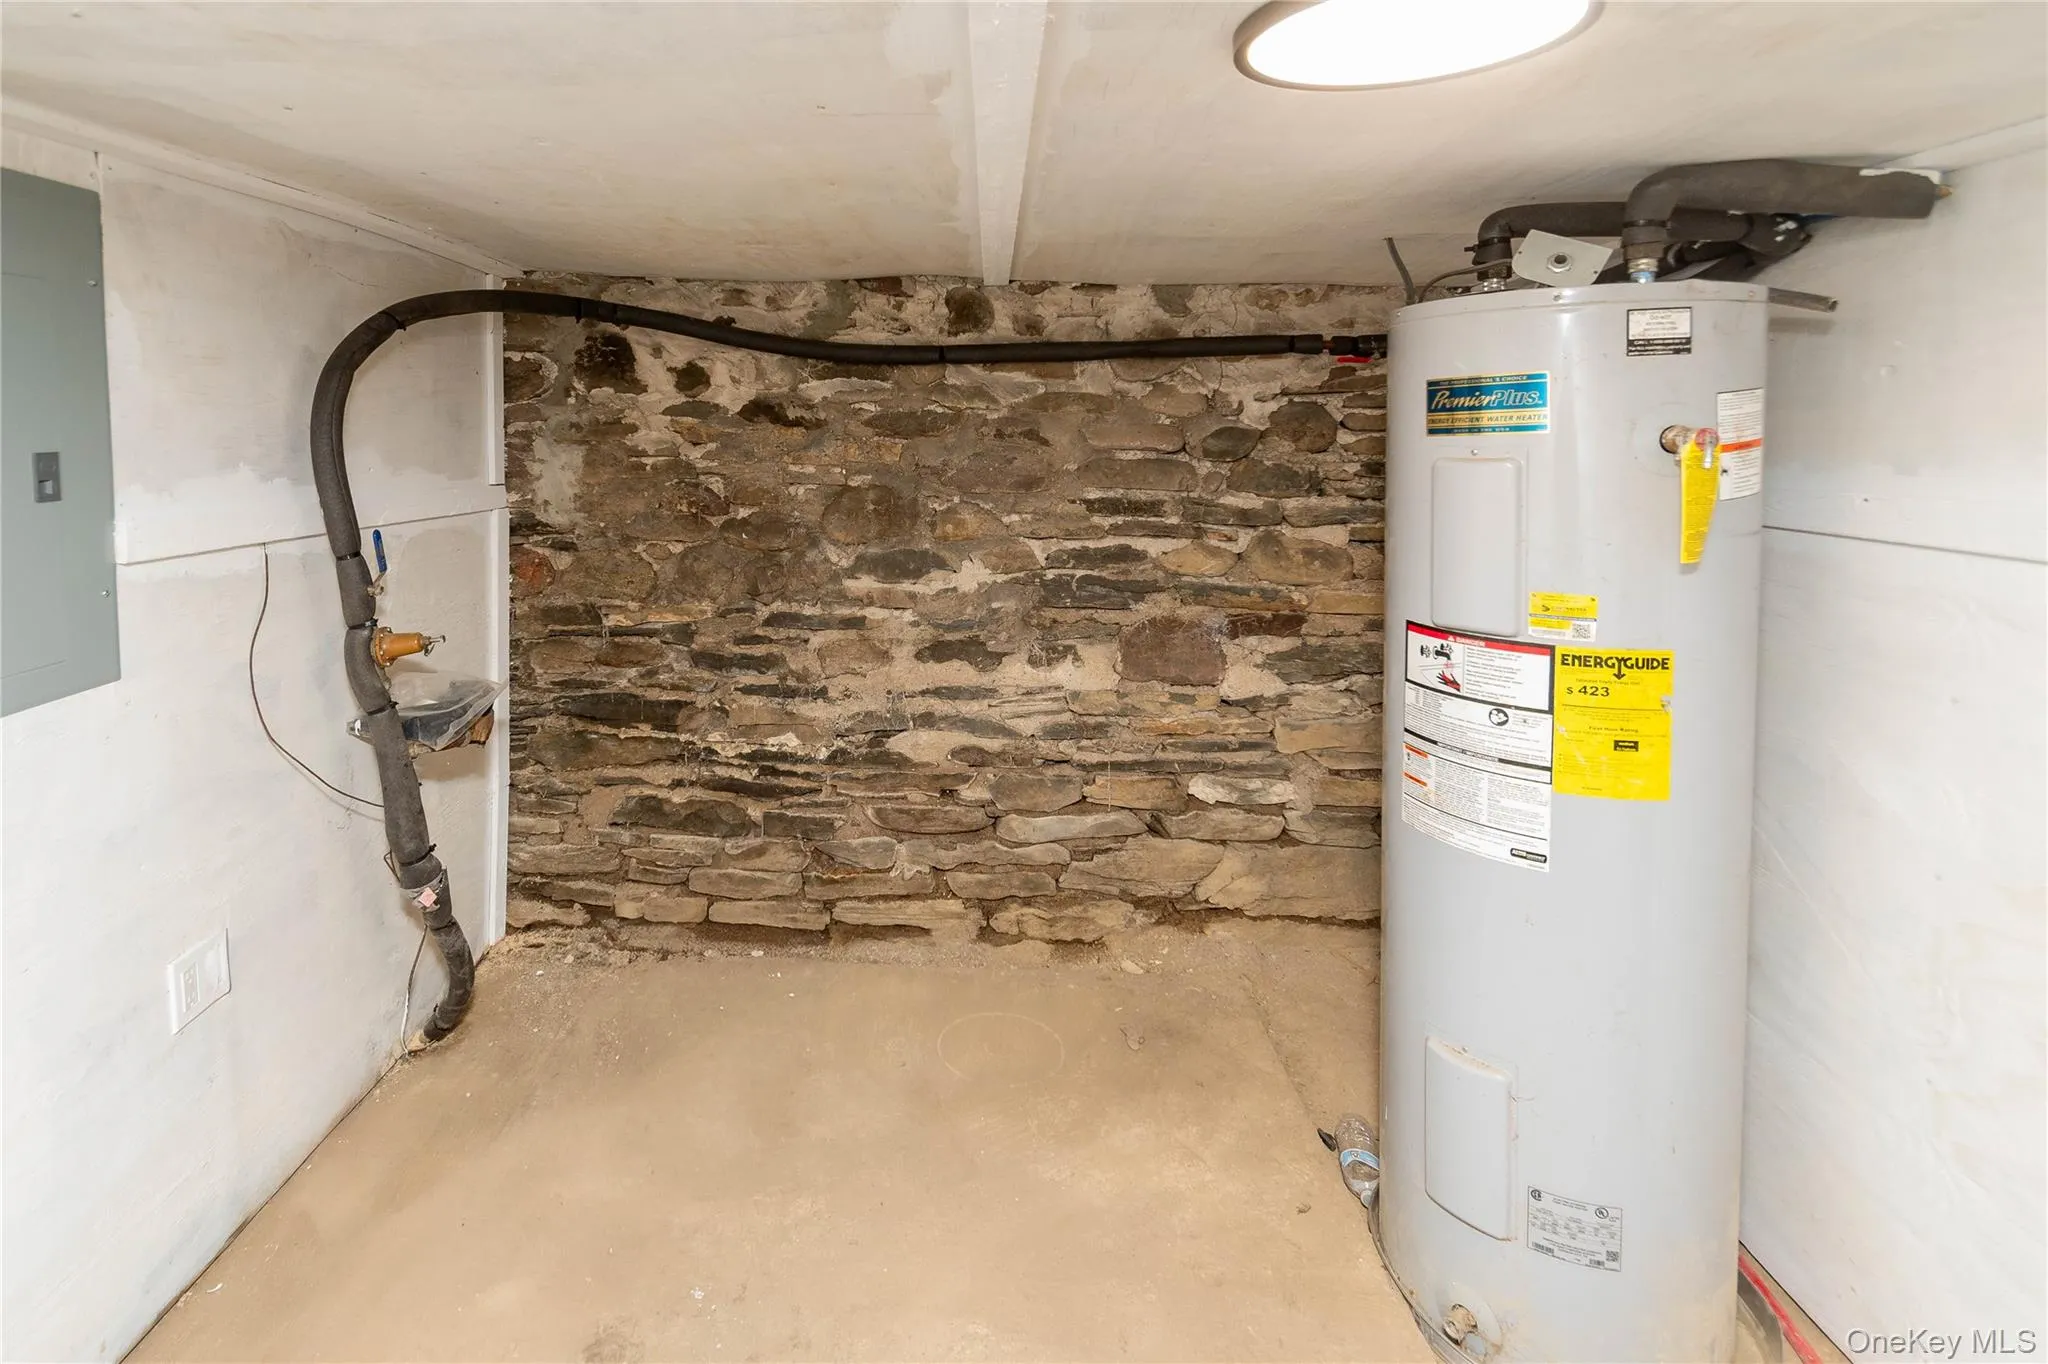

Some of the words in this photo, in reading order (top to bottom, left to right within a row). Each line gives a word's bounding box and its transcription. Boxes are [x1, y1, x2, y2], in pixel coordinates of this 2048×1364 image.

[1487, 415, 1514, 423] WATER
[1515, 413, 1547, 422] HEATER
[1561, 654, 1670, 671] ENERGYGUIDE
[1578, 685, 1610, 697] 423
